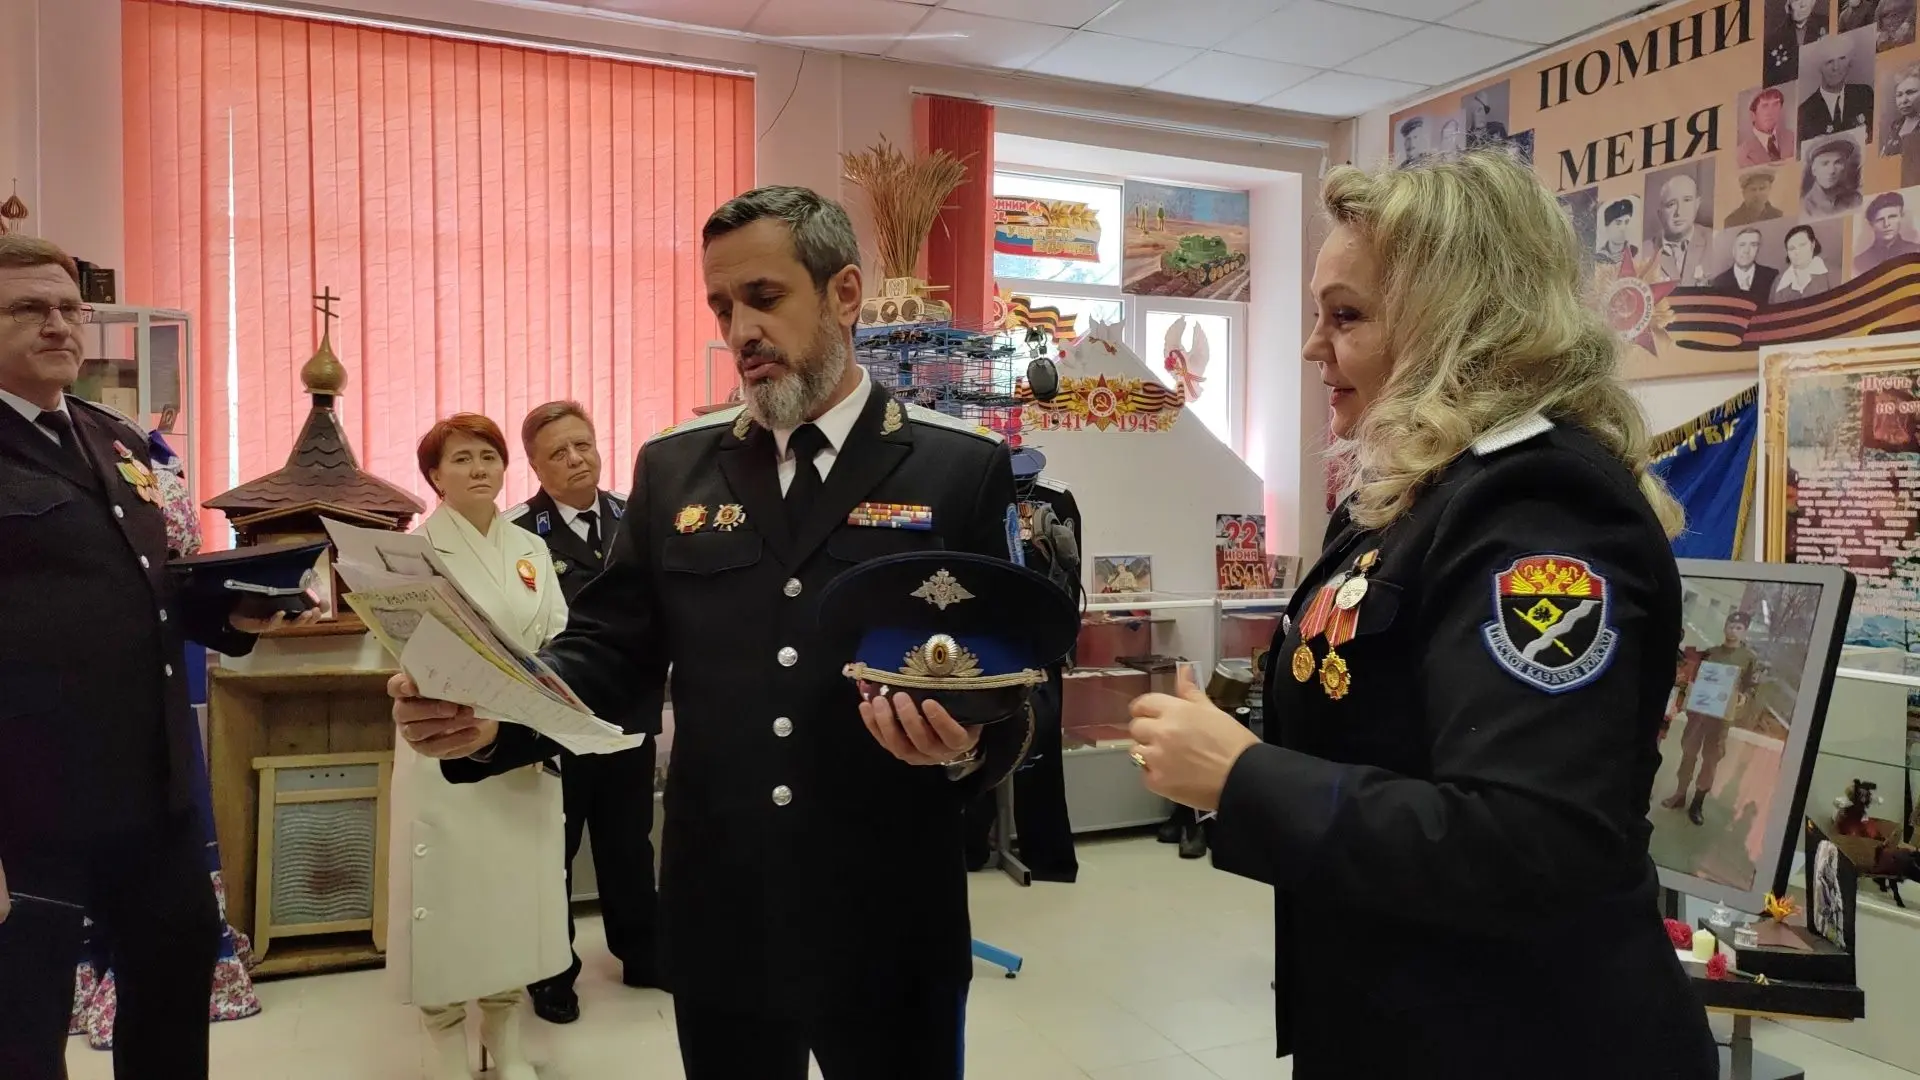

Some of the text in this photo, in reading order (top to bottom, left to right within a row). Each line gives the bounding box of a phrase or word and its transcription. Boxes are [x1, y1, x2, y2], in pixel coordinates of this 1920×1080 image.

[1536, 0, 1754, 112] ПОМНИ
[1557, 104, 1723, 191] МЕНЯ
[992, 199, 1027, 212] ОМНИМ
[1041, 412, 1081, 431] 1941
[1119, 413, 1158, 432] 1945
[1224, 520, 1257, 549] 22
[1224, 550, 1258, 561] ИЮНЯ
[1221, 563, 1266, 590] 1941
